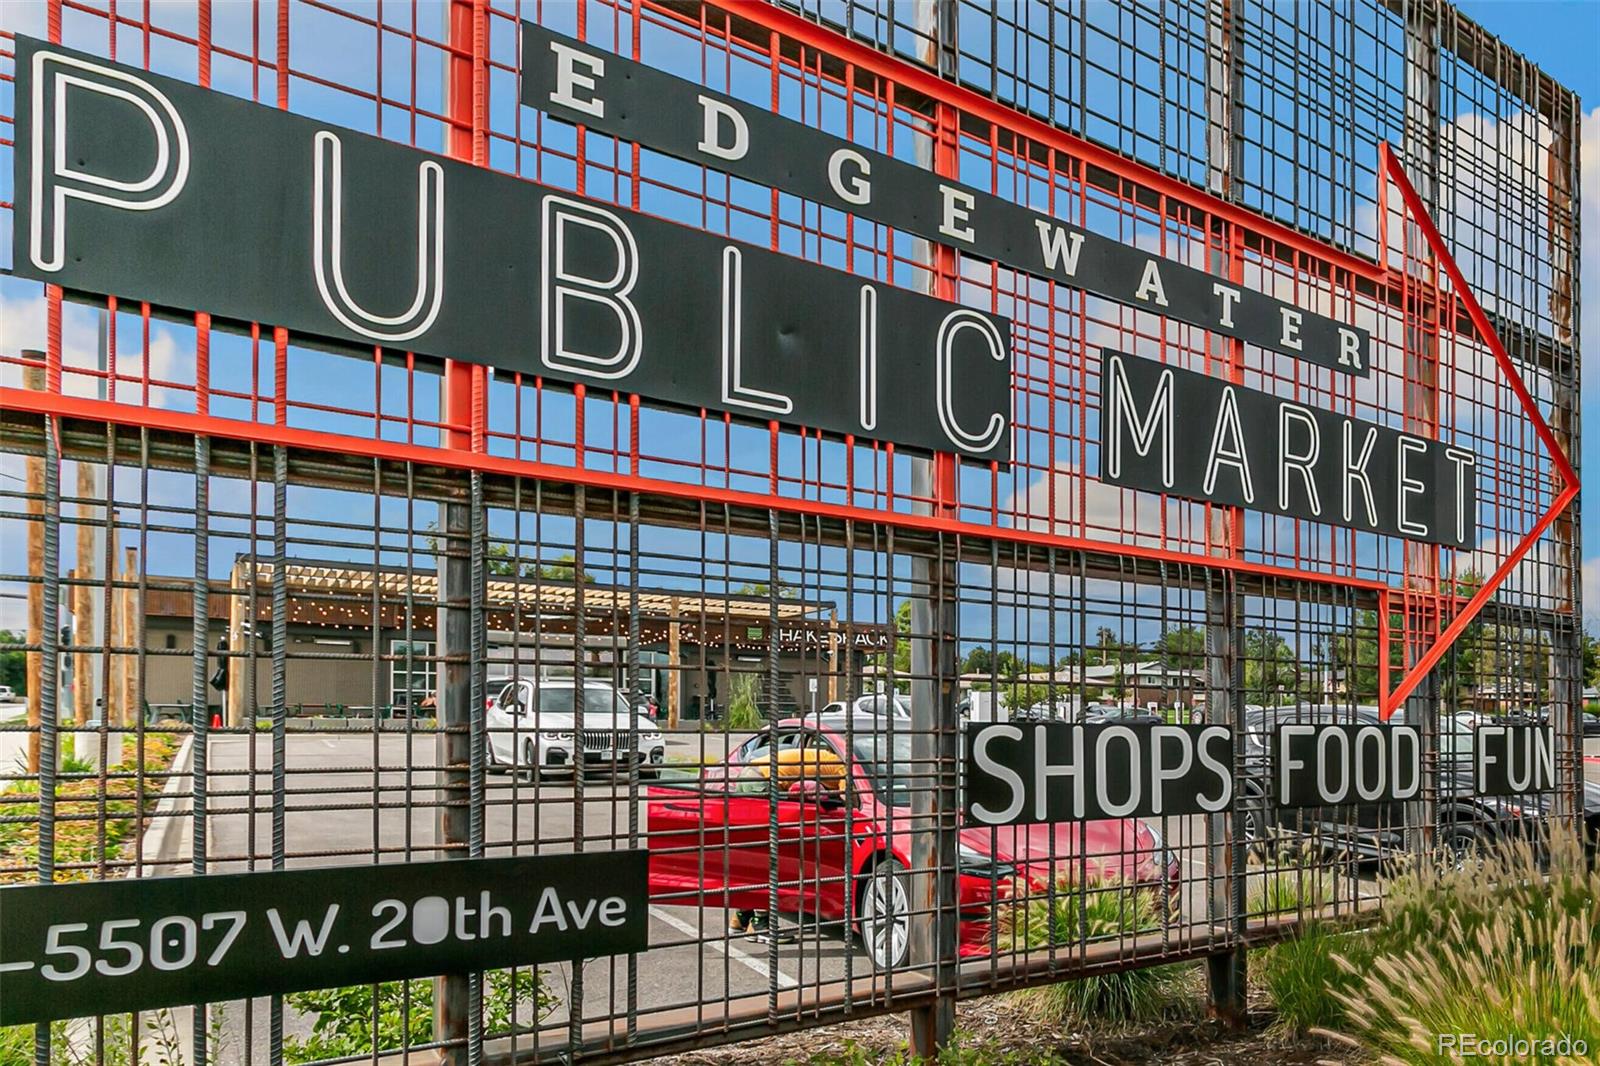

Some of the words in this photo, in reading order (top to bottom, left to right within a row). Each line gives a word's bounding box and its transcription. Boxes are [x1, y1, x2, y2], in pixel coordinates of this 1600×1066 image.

[550, 41, 1363, 371] EDGEWATER
[29, 50, 1005, 453] PUBLIC
[1108, 355, 1475, 544] MARKET
[971, 725, 1232, 824] SHOPS
[1281, 725, 1420, 804] FOOD
[1478, 726, 1556, 793] FUN
[266, 904, 350, 958] W.
[370, 890, 512, 950] 20th
[529, 887, 627, 934] Ave
